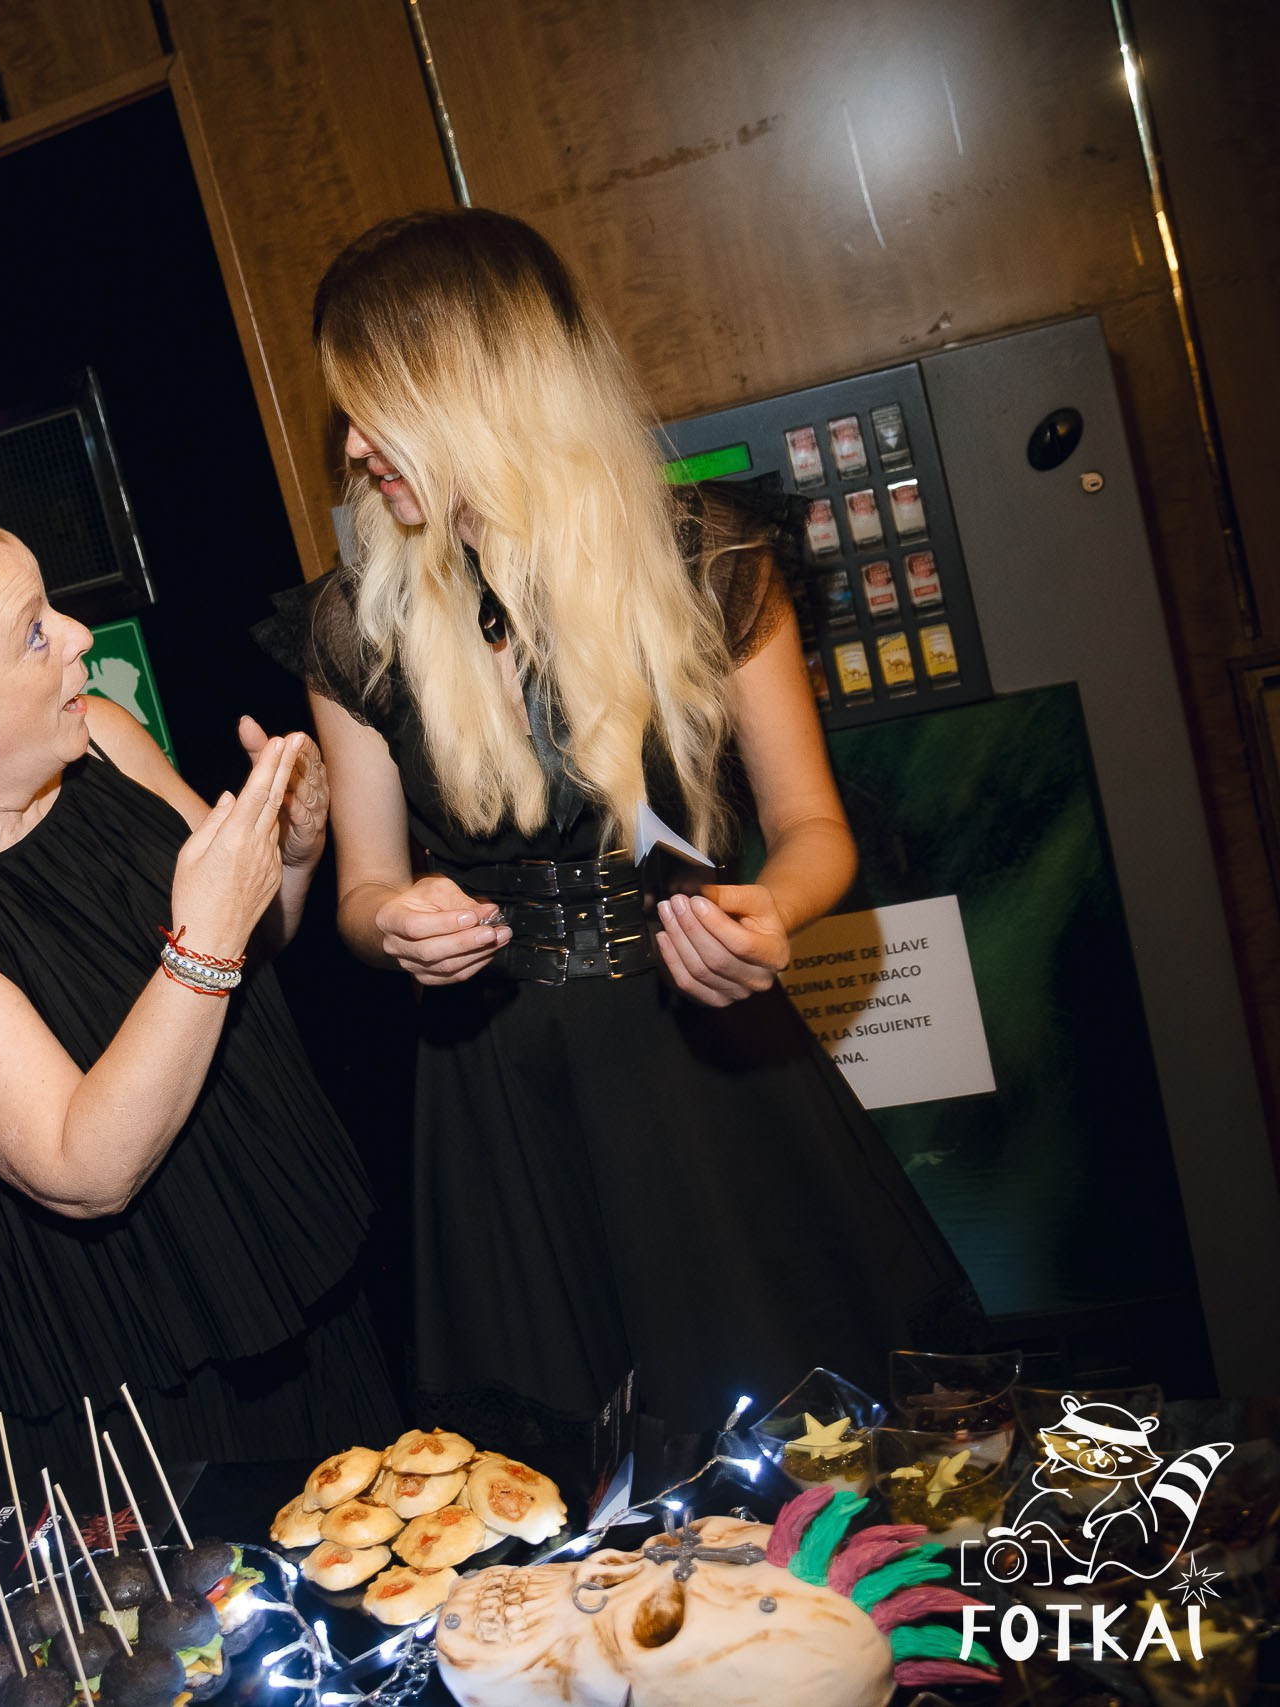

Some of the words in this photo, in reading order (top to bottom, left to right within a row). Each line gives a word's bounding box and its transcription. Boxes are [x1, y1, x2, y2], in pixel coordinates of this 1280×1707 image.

[794, 950, 857, 970] DISPONE
[861, 945, 881, 960] DE
[885, 937, 930, 956] LLAVE
[786, 979, 835, 997] QUINA
[838, 977, 857, 989] DE
[861, 964, 922, 985] TABACO
[803, 1007, 822, 1020] DE
[825, 992, 912, 1016] INCIDENCIA
[833, 1027, 853, 1041] LA
[856, 1014, 933, 1038] SIGUIENTE
[832, 1051, 870, 1066] ANA.
